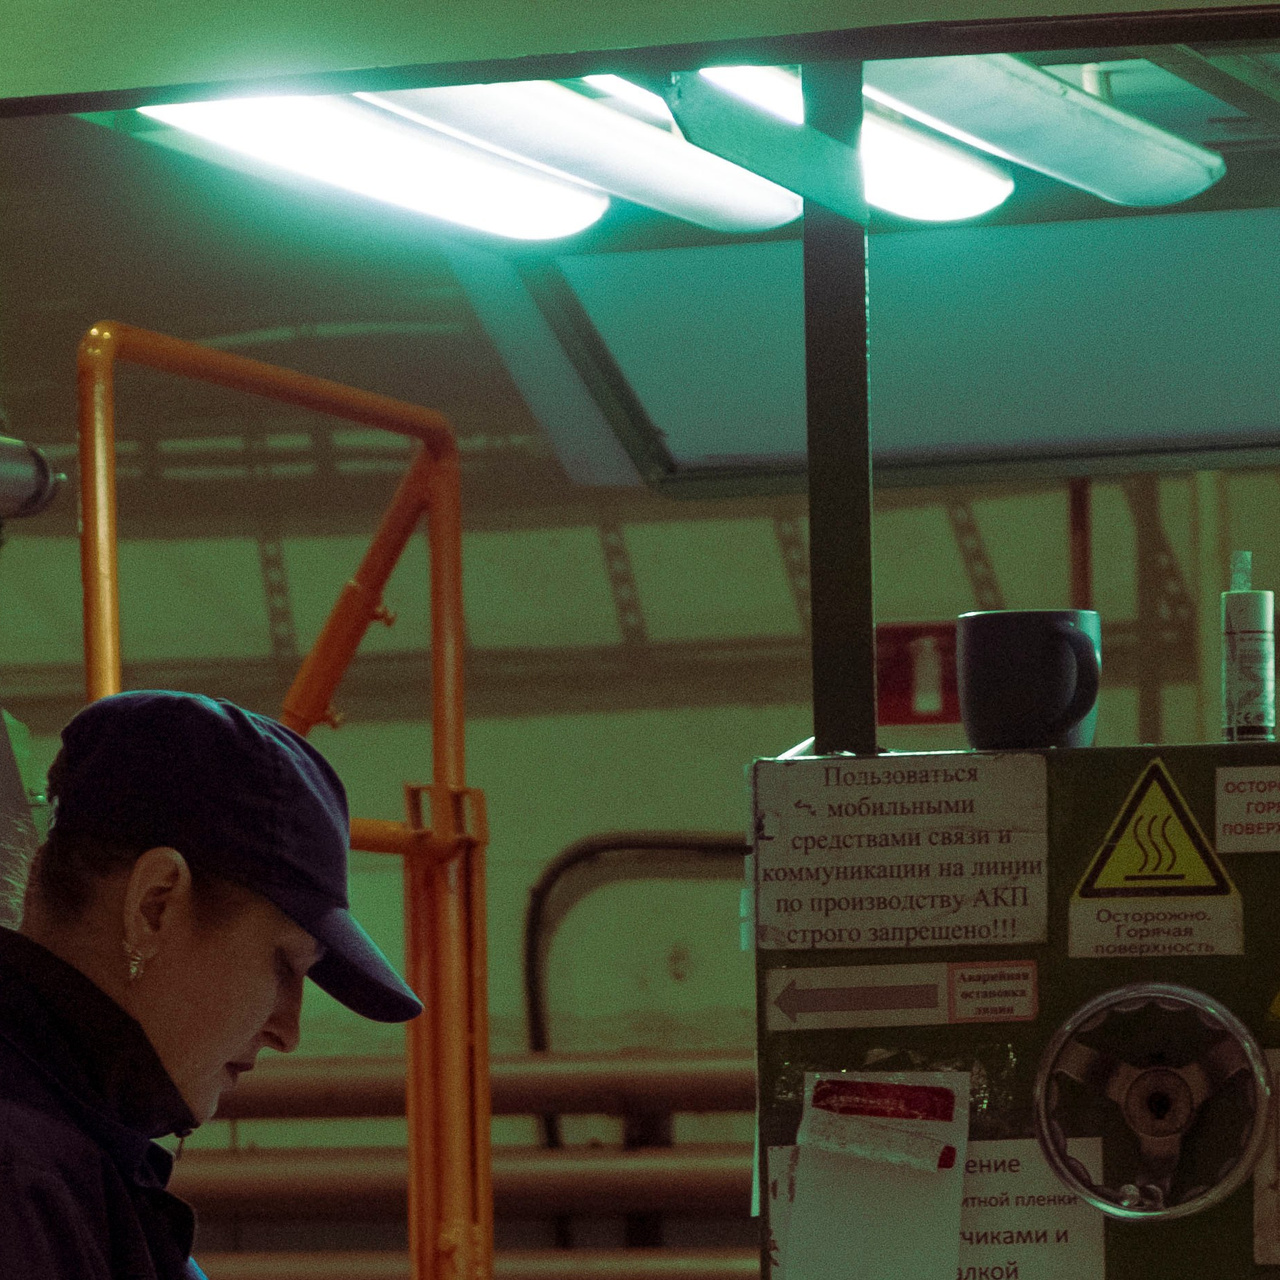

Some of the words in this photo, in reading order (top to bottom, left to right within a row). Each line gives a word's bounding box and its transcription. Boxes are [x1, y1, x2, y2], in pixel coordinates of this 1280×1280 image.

[823, 765, 979, 787] Пользоваться
[1223, 781, 1280, 793] ОСТОР
[827, 796, 975, 818] мобильными
[791, 832, 921, 855] средствами
[928, 829, 990, 846] связи
[998, 829, 1012, 845] и
[762, 862, 931, 885] коммуникации
[938, 862, 965, 878] на
[970, 860, 1043, 877] линии
[775, 898, 803, 914] по
[810, 892, 966, 917] производству
[973, 887, 1030, 908] АКП
[1096, 908, 1211, 924] Осторожно.
[786, 926, 862, 948] строго
[869, 918, 1017, 947] запрещено!!!
[1115, 925, 1194, 940] Горячая
[1094, 941, 1215, 956] поверхность
[965, 1158, 1020, 1174] ение
[961, 1191, 1010, 1208] итной
[1015, 1194, 1078, 1207] пленки
[960, 1229, 1049, 1245] чиками
[1055, 1228, 1069, 1244] и
